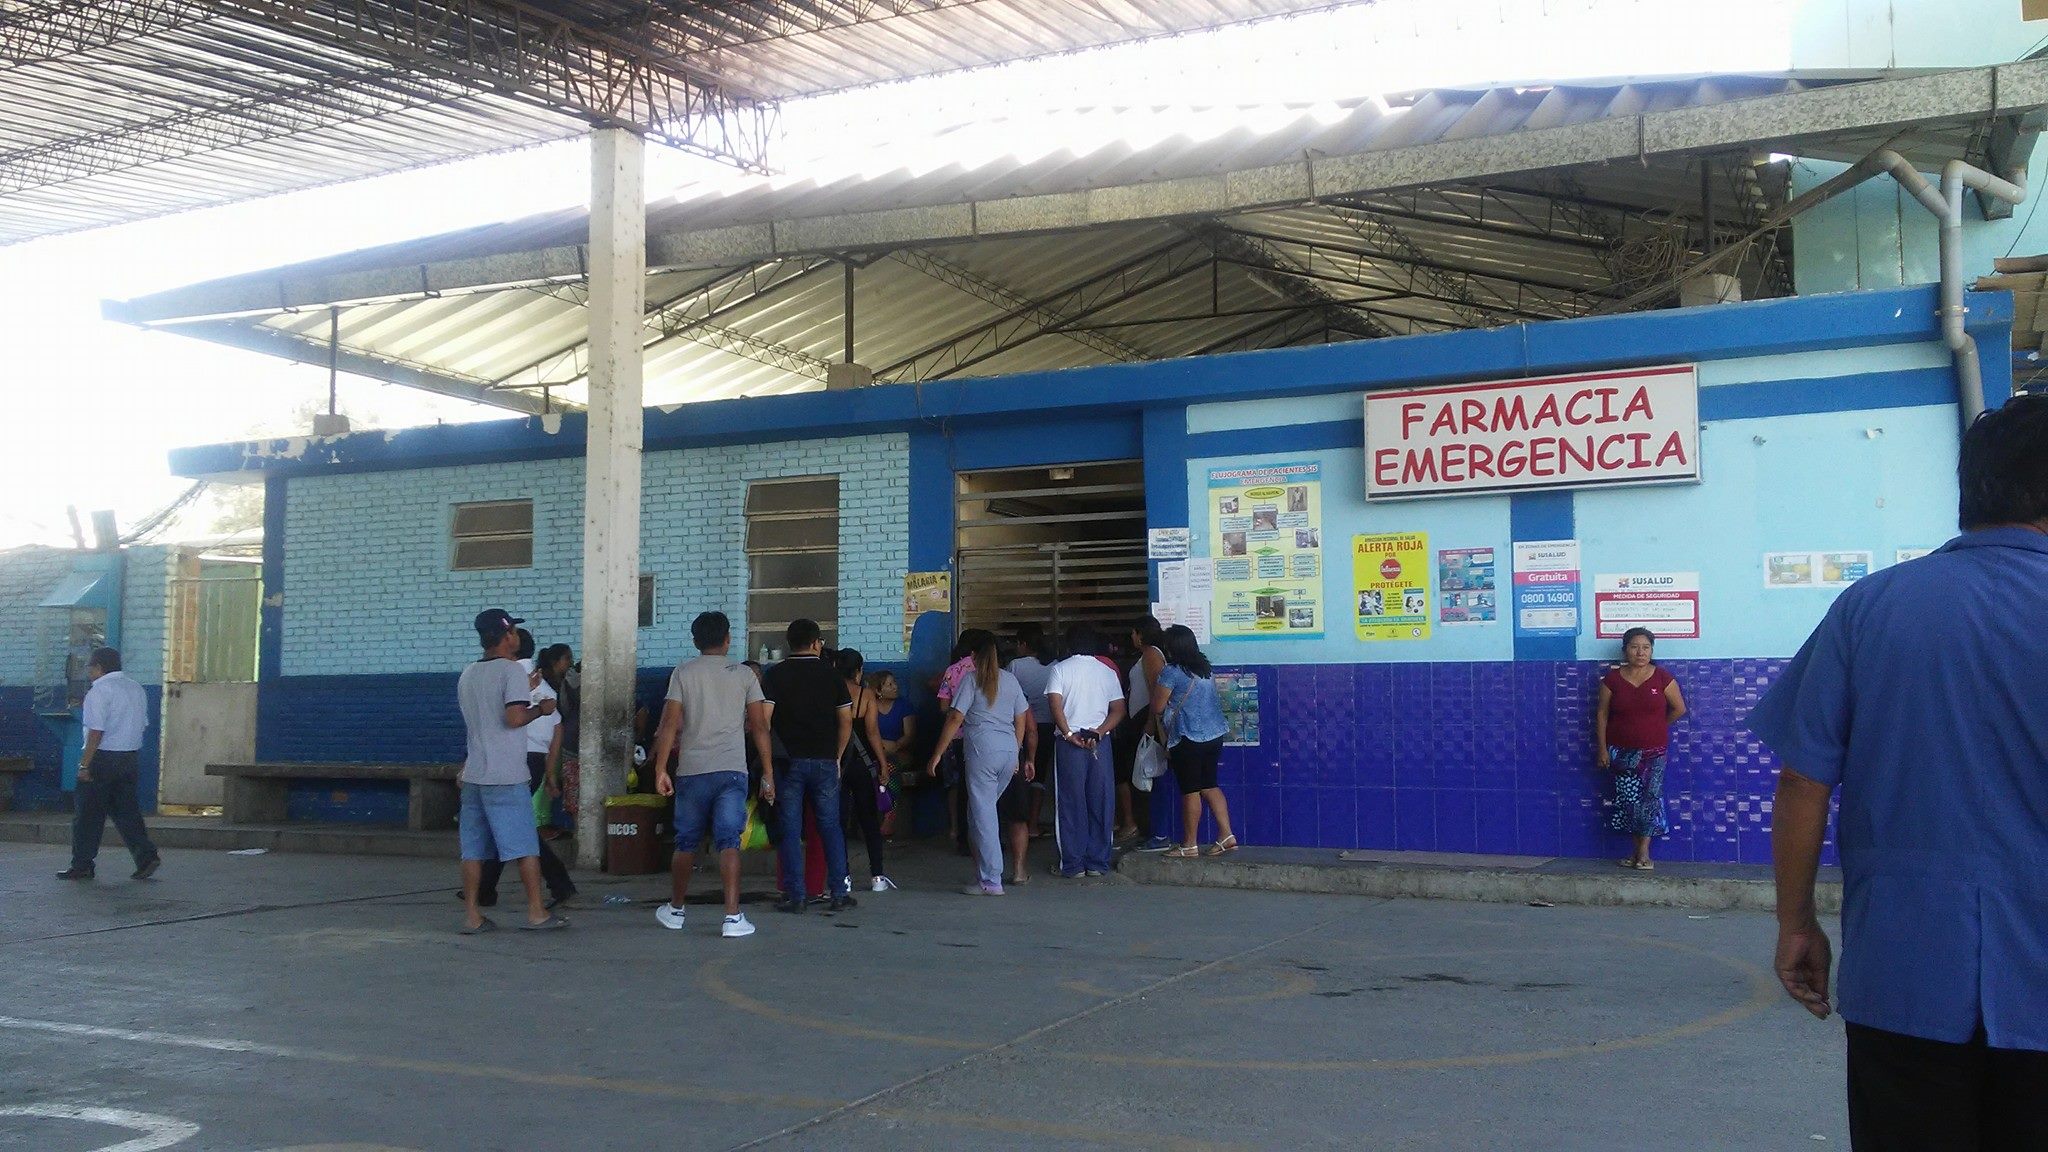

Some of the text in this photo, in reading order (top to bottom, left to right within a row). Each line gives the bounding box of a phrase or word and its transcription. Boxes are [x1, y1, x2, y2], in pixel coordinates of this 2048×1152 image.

[1402, 385, 1654, 440] FARMACIA
[1375, 430, 1687, 486] EMERGENCIA
[1211, 468, 1257, 480] FLUJOGRAMA
[1258, 468, 1267, 476] DE
[1268, 465, 1306, 475] PACIENTES
[1241, 476, 1287, 485] EMERGENCIA
[1358, 540, 1424, 553] ALERTA ROJA
[906, 575, 938, 590] MALARIA
[1528, 572, 1567, 582] Gratuita
[1632, 577, 1674, 585] SUSALUD
[1521, 592, 1574, 603] 0800 14900
